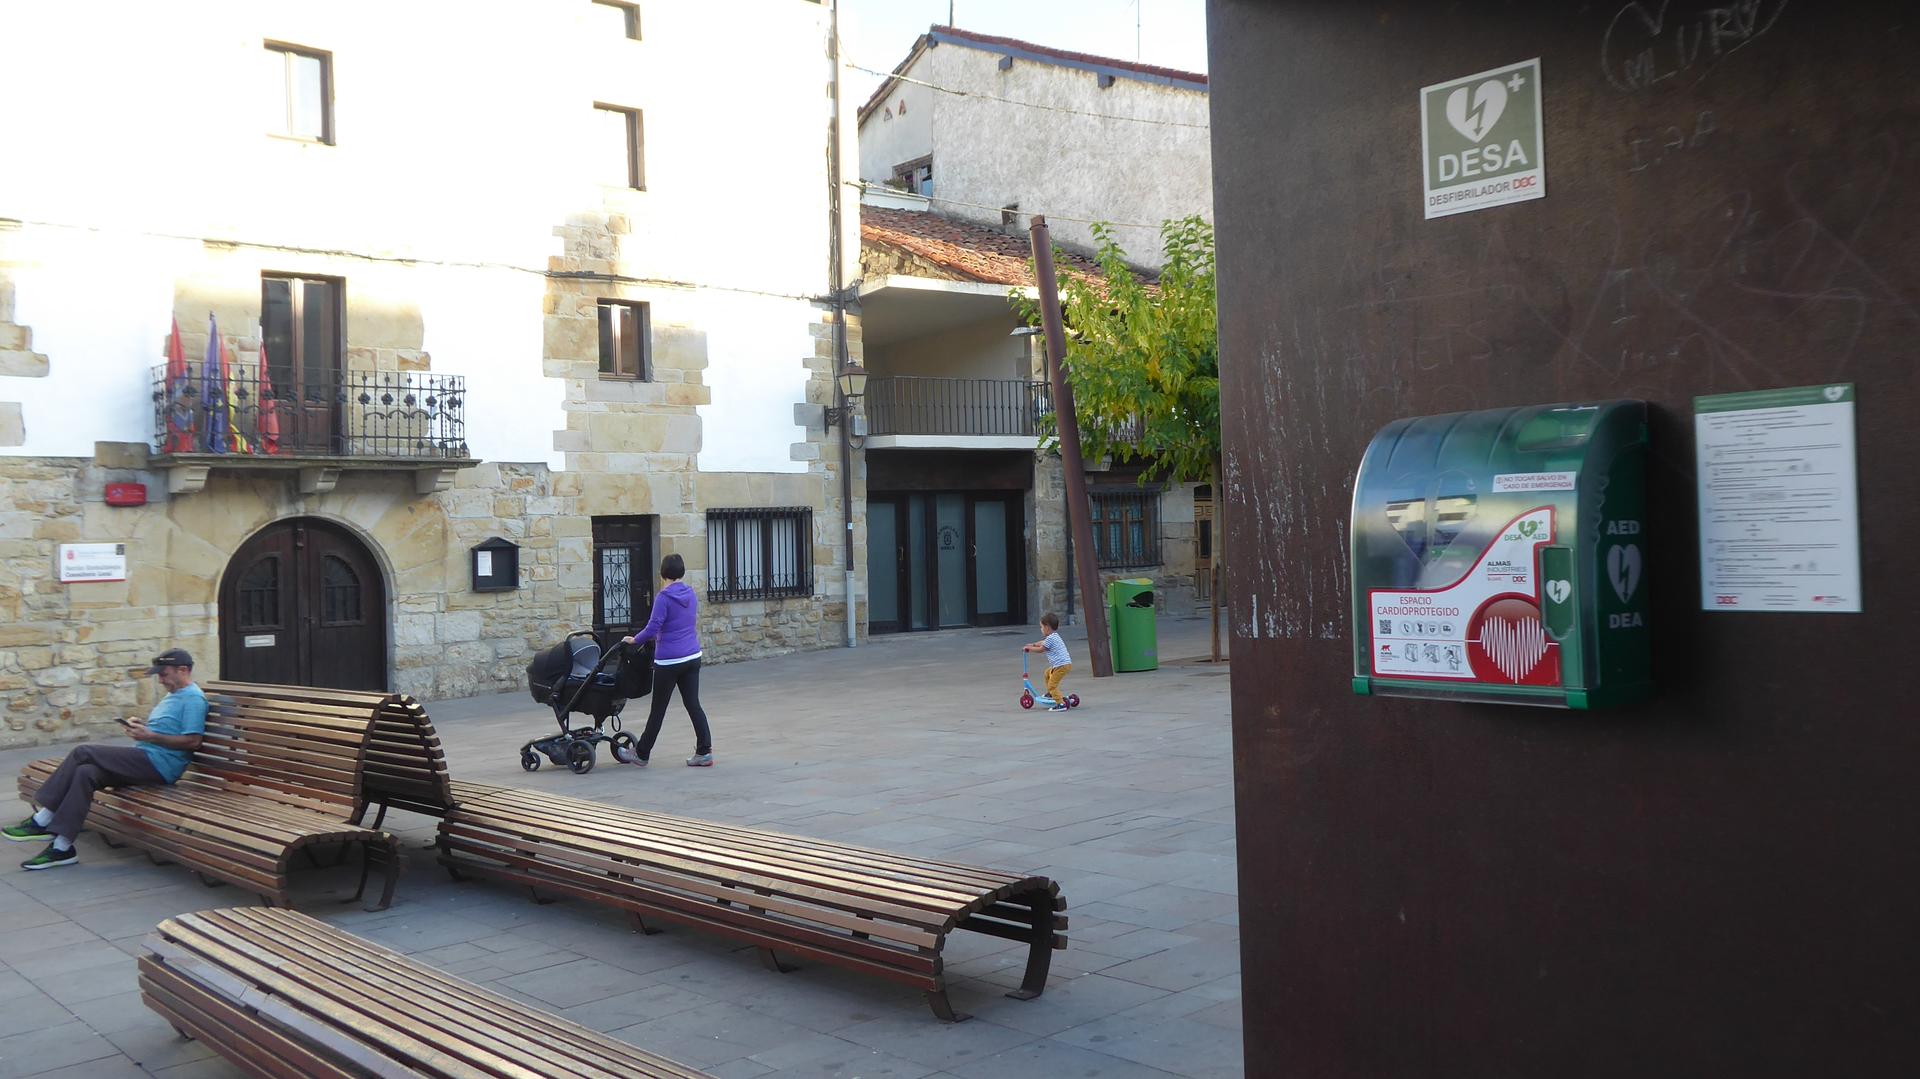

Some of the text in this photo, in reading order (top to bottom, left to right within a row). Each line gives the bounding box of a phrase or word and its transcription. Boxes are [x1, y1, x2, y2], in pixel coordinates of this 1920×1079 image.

[1439, 139, 1528, 182] DESA
[1430, 182, 1510, 206] DESFIBRILADOR
[1606, 520, 1640, 535] AED
[1399, 596, 1432, 605] ESPACIO
[1377, 606, 1460, 617] CARDIOPROTEGIDO
[1609, 612, 1642, 629] DEA
